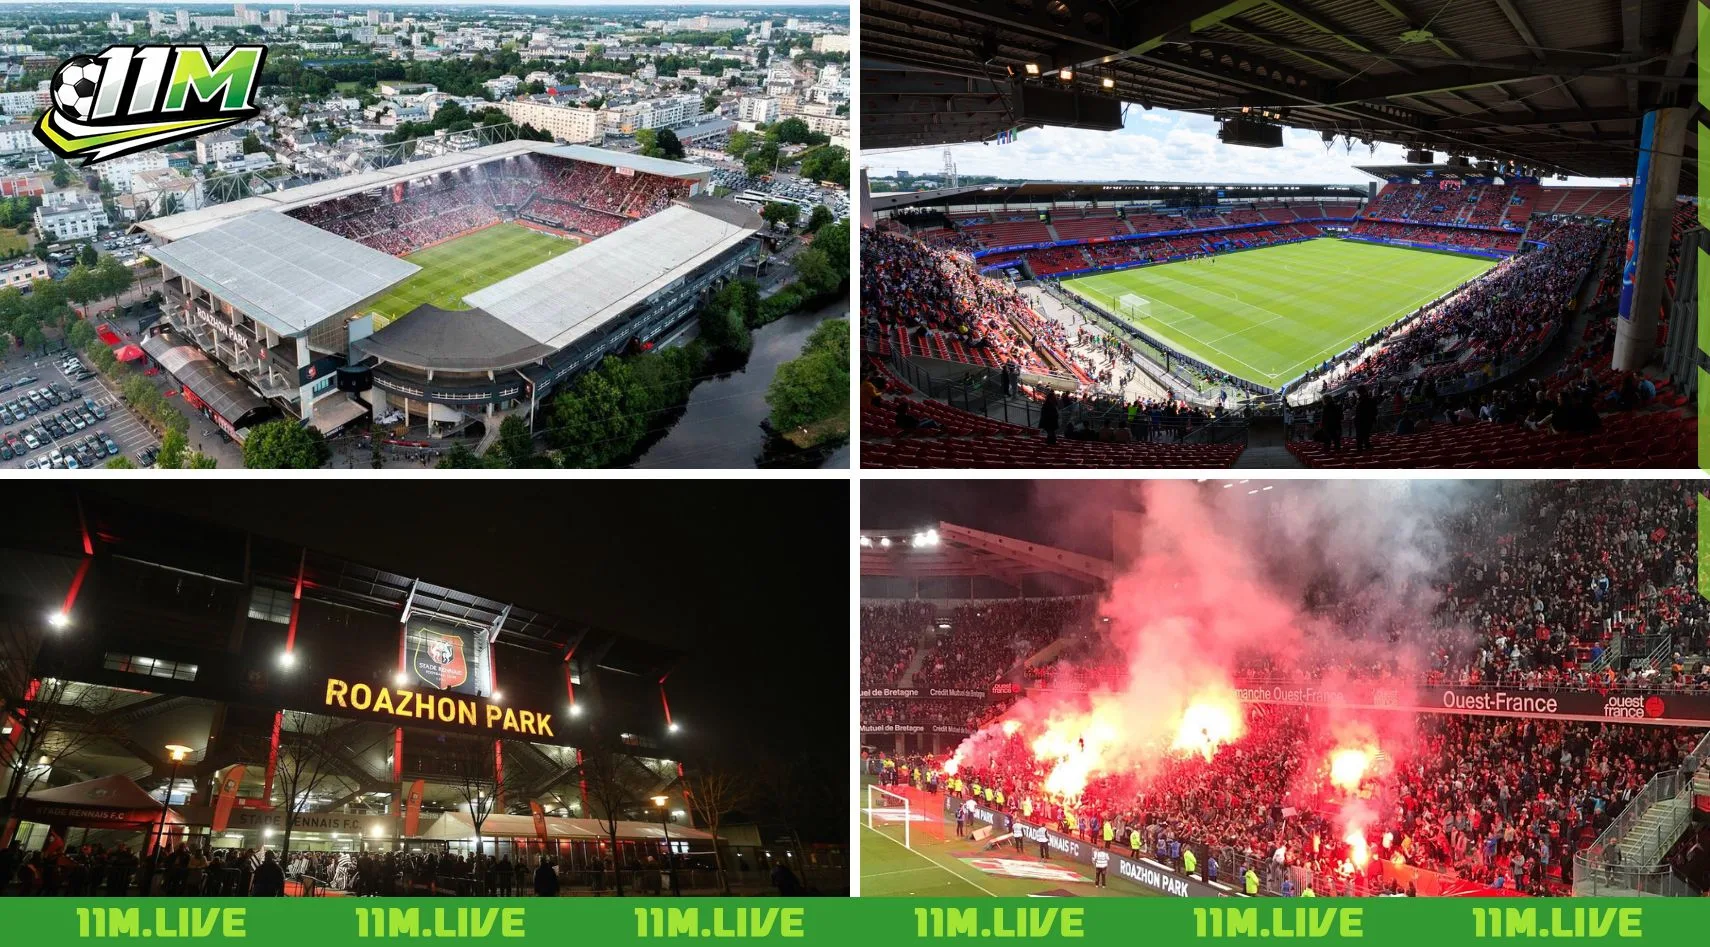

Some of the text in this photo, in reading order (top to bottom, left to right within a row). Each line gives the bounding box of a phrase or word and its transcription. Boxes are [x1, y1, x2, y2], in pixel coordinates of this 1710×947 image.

[197, 307, 249, 350] ROAZHON PARK
[884, 689, 919, 697] Bretagne
[325, 678, 554, 737] ROAZHON PARK
[1443, 691, 1558, 713] Ouest-France
[1608, 695, 1645, 707] ouest
[1604, 704, 1645, 719] france
[894, 724, 924, 732] Bretagne
[68, 808, 109, 819] RENNAIS
[239, 813, 362, 829] STADE ENNAIS F.C.
[980, 810, 994, 825] PARK
[1069, 842, 1080, 857] FC
[1120, 860, 1189, 897] ROAZHON PARK
